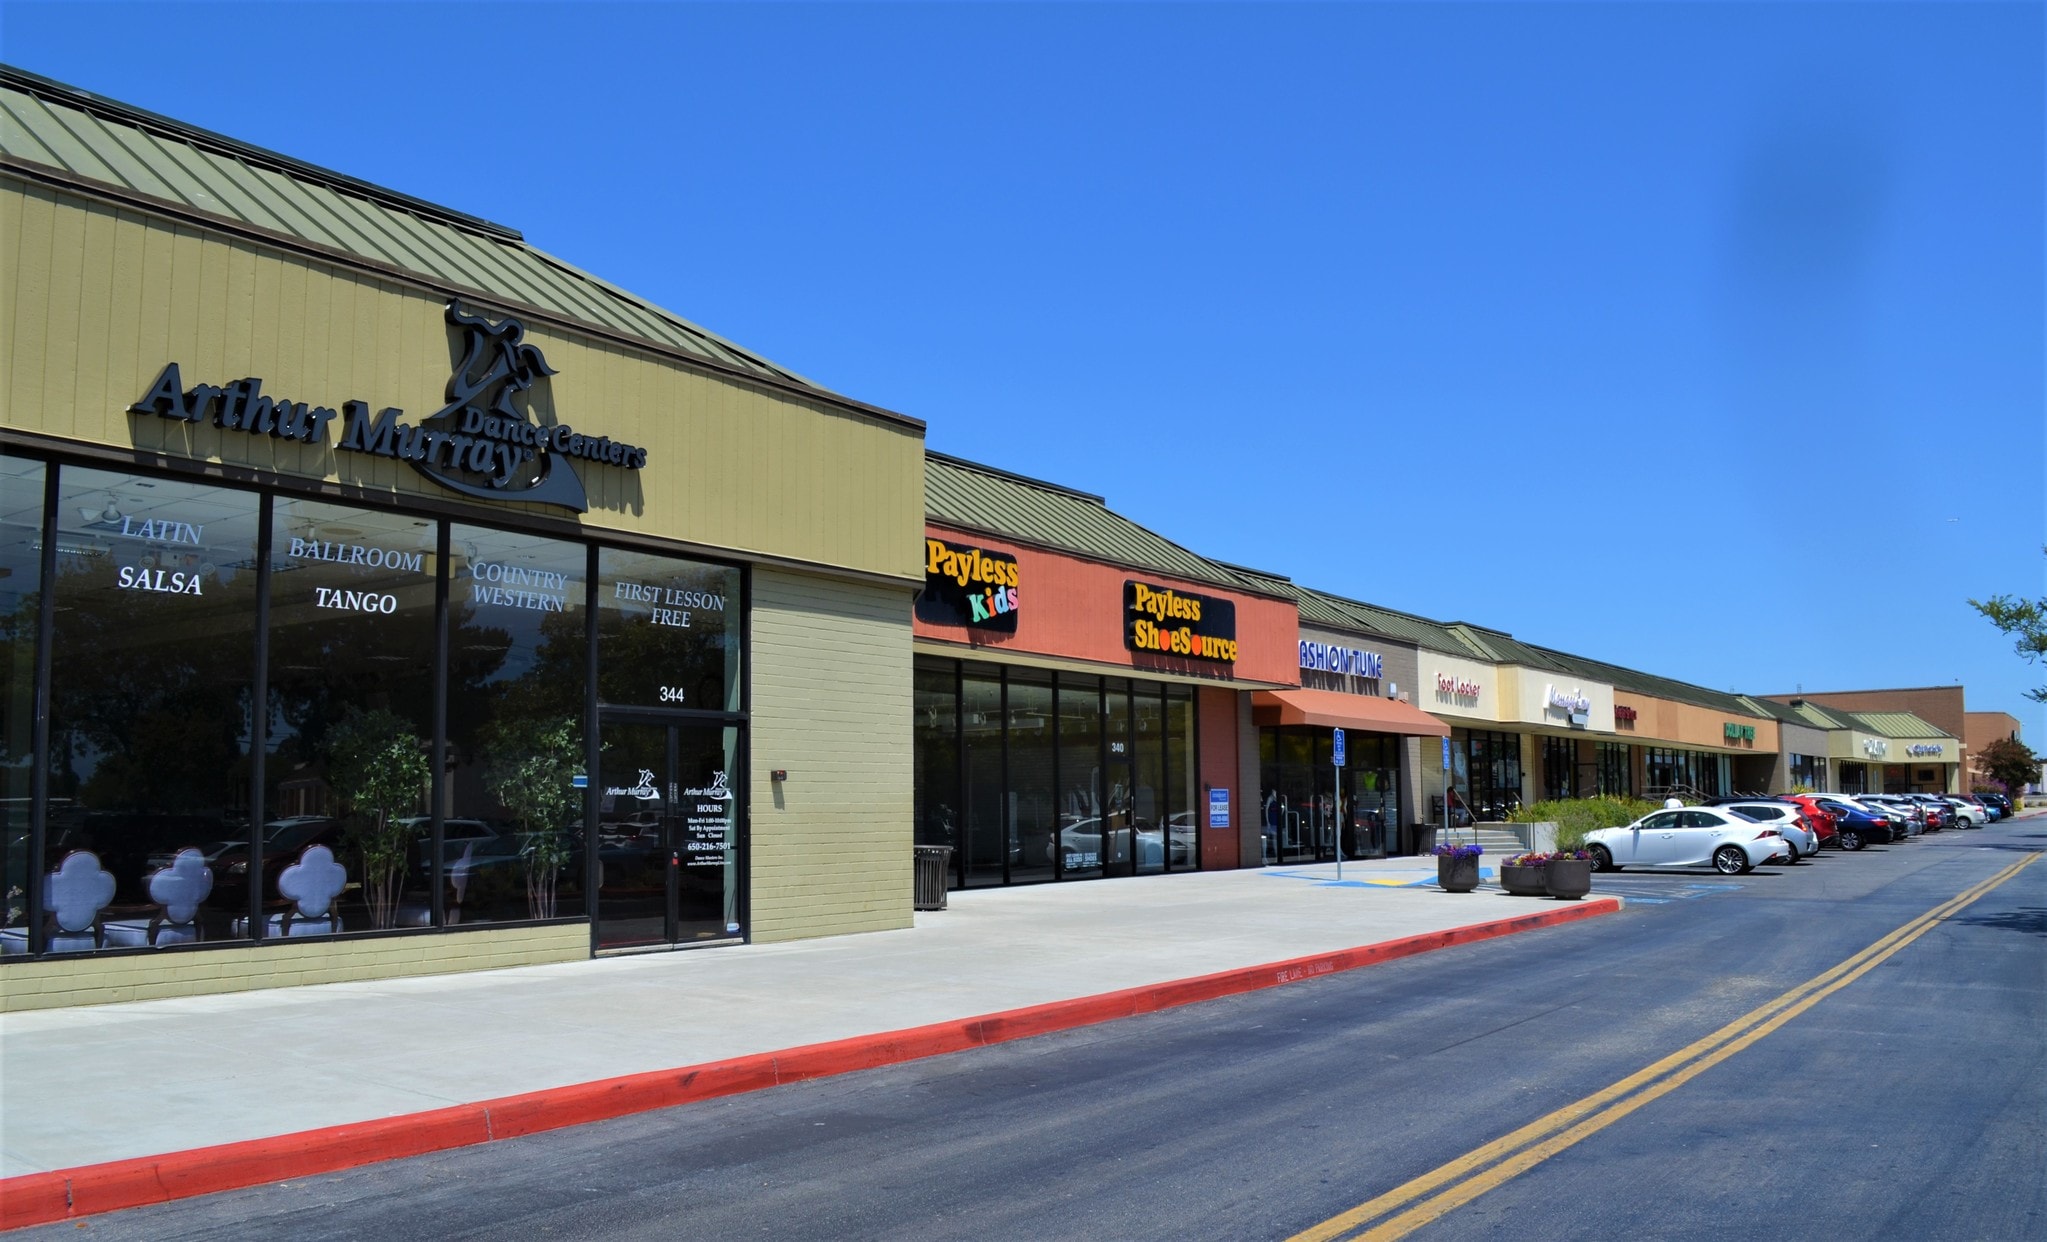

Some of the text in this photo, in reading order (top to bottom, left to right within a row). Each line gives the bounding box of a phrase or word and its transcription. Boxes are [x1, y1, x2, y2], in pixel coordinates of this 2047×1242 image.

[126, 362, 337, 444] Arthur
[461, 406, 647, 468] Dance Centers
[121, 515, 203, 545] LATIN
[289, 537, 423, 573] BALLROOM
[927, 539, 1018, 587] Payless
[118, 566, 203, 595] SALSA
[472, 562, 568, 591] COUNTRY
[315, 587, 397, 614] TANGO
[473, 584, 566, 613] WESTERN
[614, 581, 726, 612] FIRST LESSON
[969, 585, 1019, 623] Kids
[1135, 583, 1201, 622] Payless
[651, 607, 692, 628] FREE
[1134, 619, 1238, 662] ShoeSource
[1352, 650, 1383, 679] TUNE
[659, 686, 685, 703] 344
[1111, 742, 1124, 753] 340
[606, 786, 627, 797] Arthur
[683, 787, 702, 797] Arthur
[697, 804, 723, 813] HOURS
[687, 842, 731, 851] 650-216-7501
[1277, 970, 1289, 983] FIRE
[1289, 967, 1303, 980] LANE
